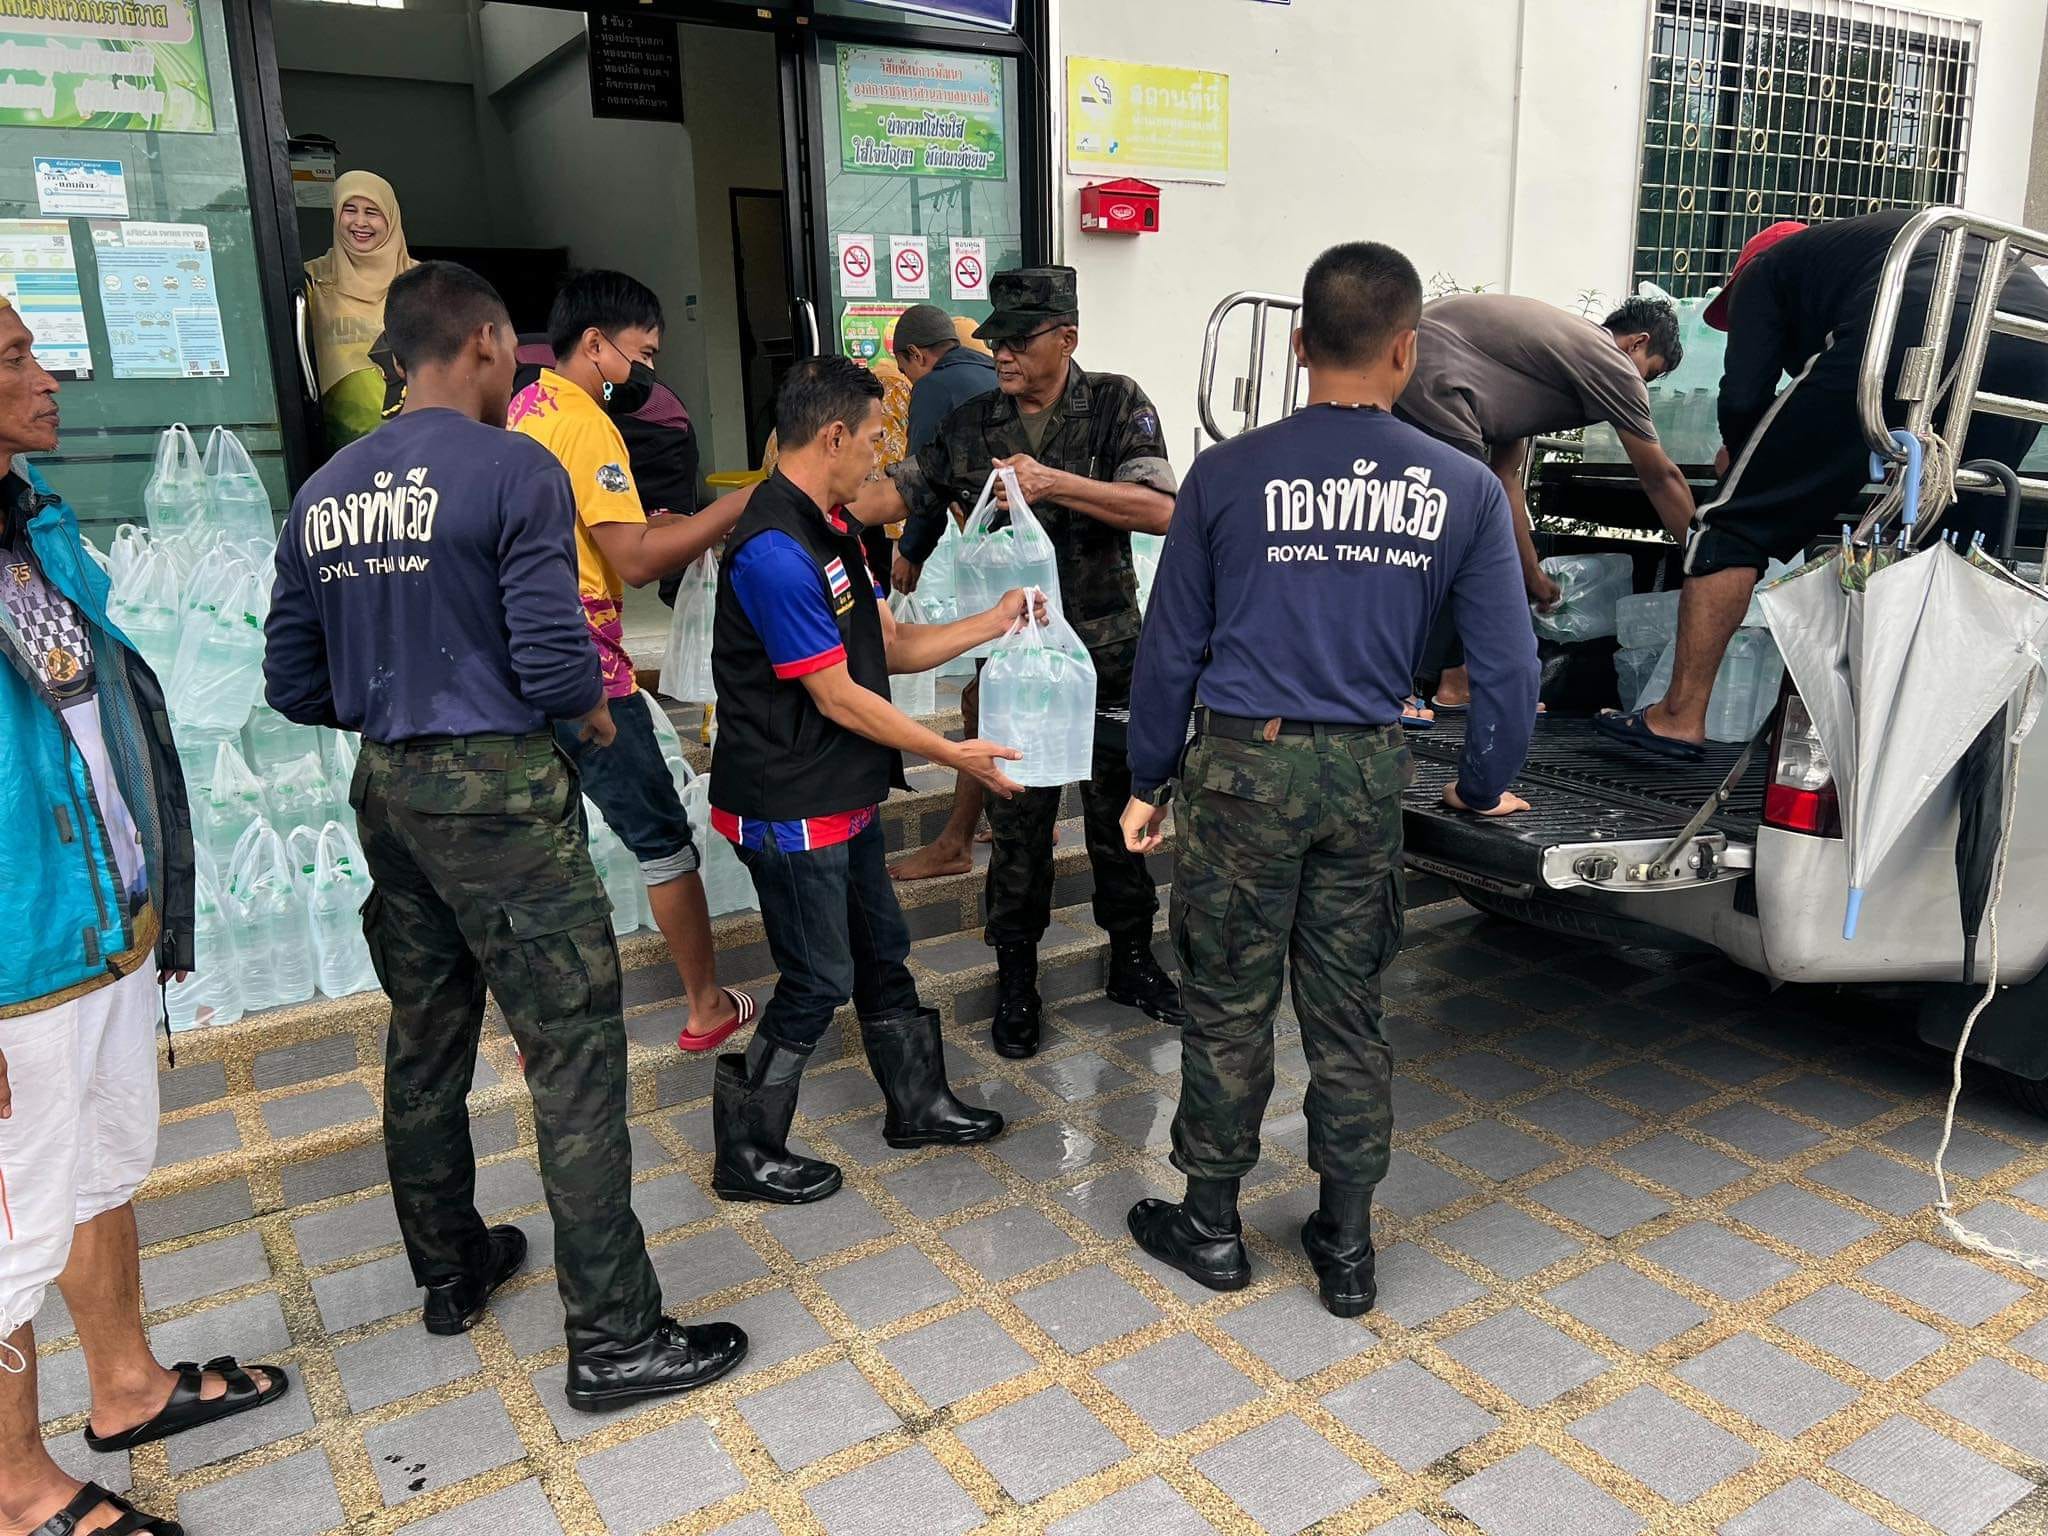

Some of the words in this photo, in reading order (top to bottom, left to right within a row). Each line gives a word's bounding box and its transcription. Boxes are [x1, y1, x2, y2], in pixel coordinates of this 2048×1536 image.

[1264, 458, 1448, 541] กองทัพเรือ
[1267, 545, 1328, 562] ROYAL
[1335, 545, 1379, 562] THAI
[1386, 548, 1432, 571] NAVY
[318, 561, 360, 583] OYAL
